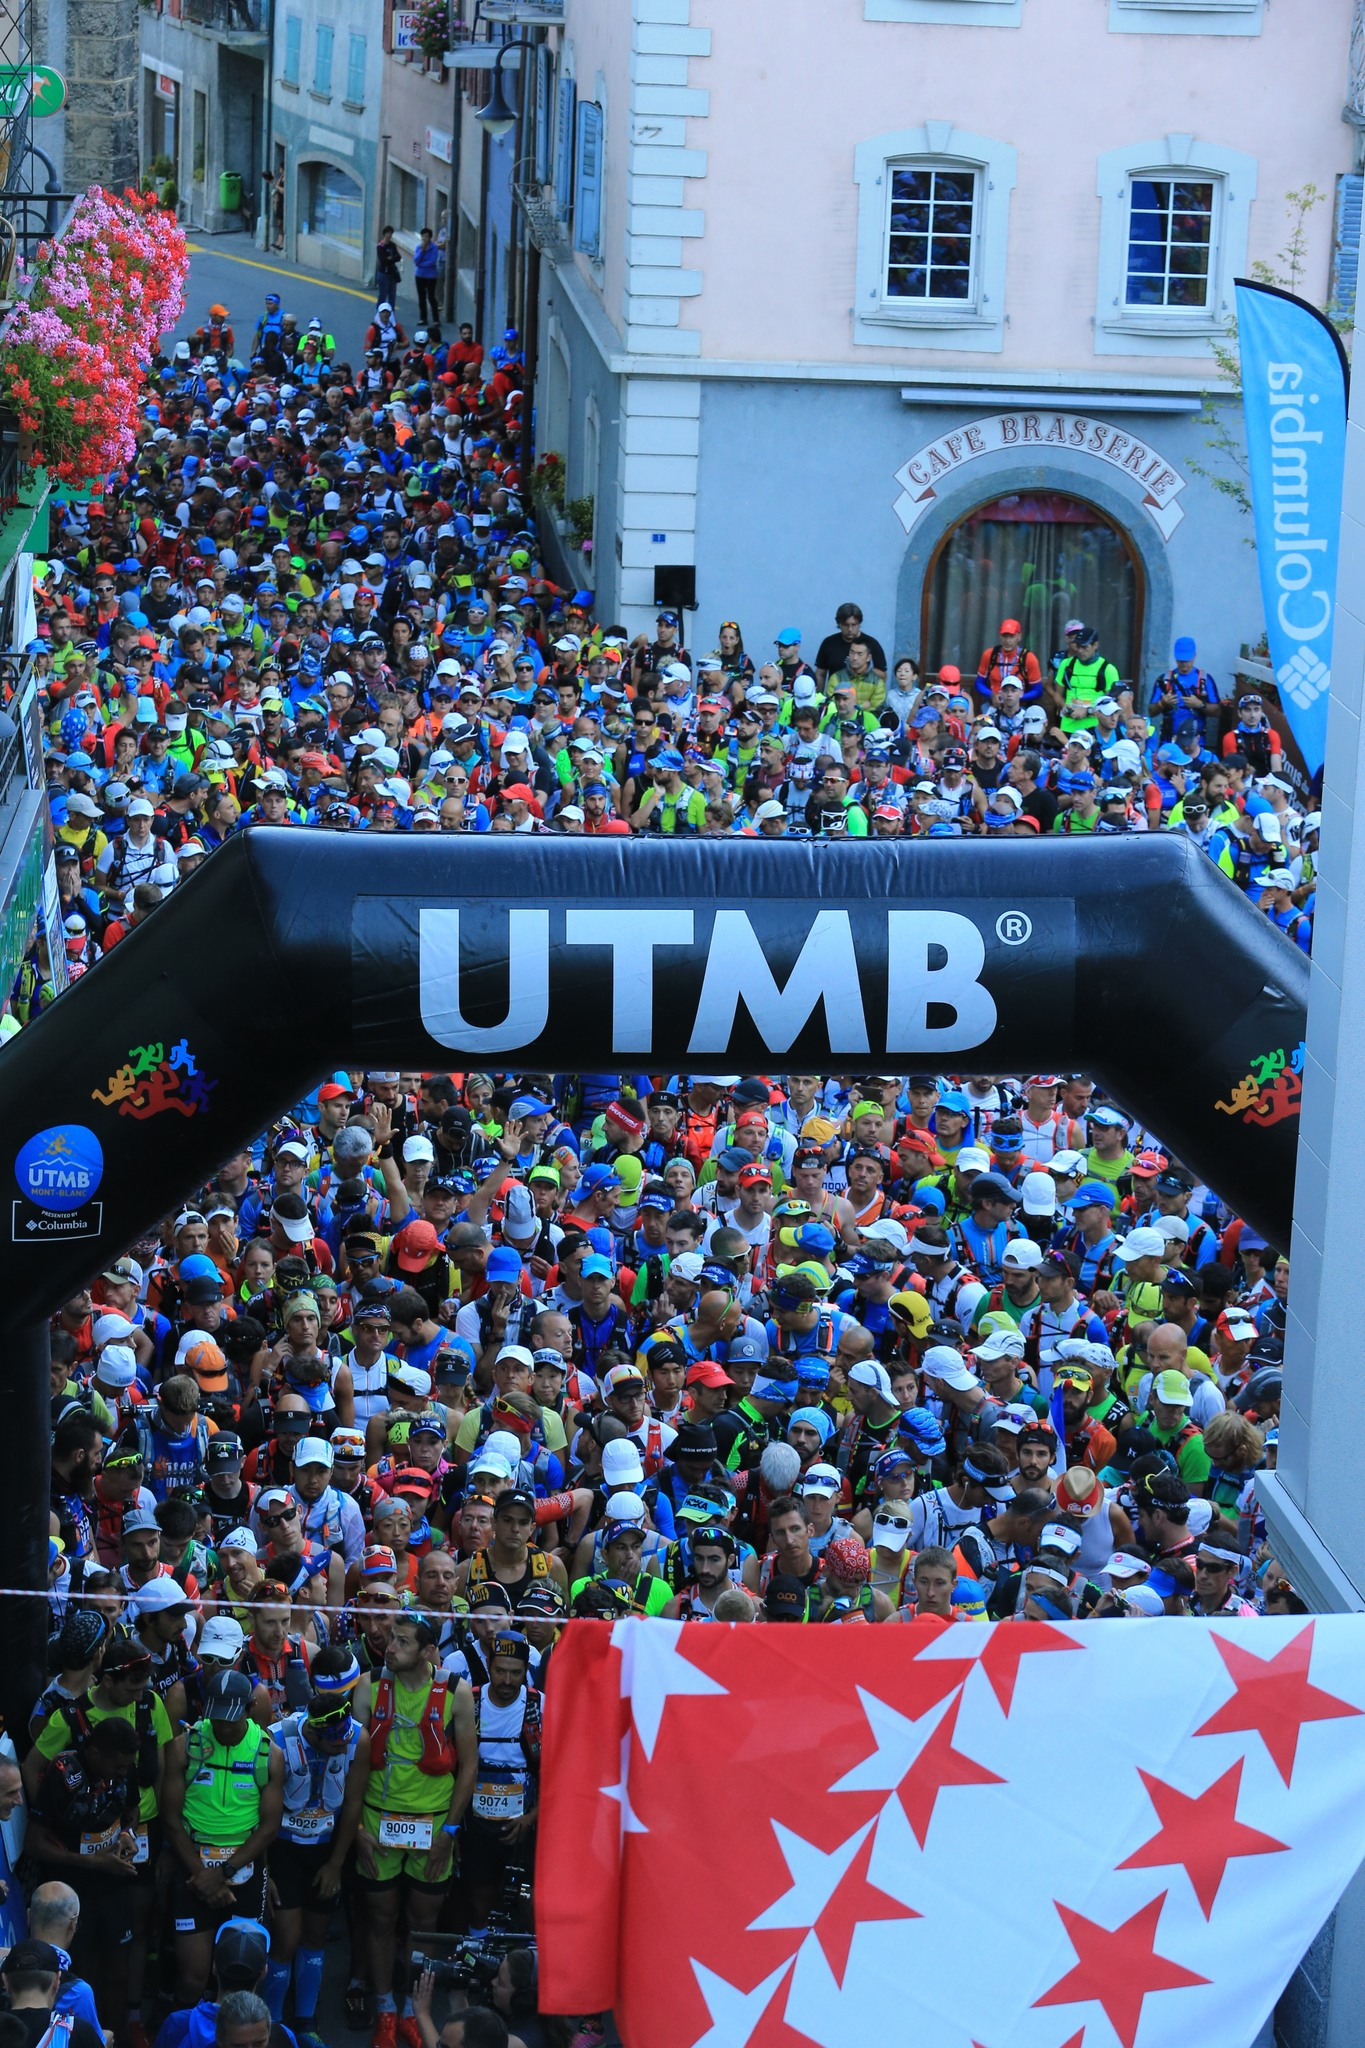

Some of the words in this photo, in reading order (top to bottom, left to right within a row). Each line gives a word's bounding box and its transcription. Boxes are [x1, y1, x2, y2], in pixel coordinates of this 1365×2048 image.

[907, 427, 985, 486] CAFE
[999, 414, 1178, 496] BRASSERIE
[28, 1167, 91, 1189] UTMB
[31, 1187, 87, 1198] MONT-BLANC
[41, 1209, 71, 1219] PRESENTED
[38, 1219, 88, 1231] Columbia
[684, 1498, 708, 1512] HOKA
[479, 1795, 508, 1807] 9074
[288, 1816, 318, 1829] 9026
[386, 1822, 416, 1835] 9009
